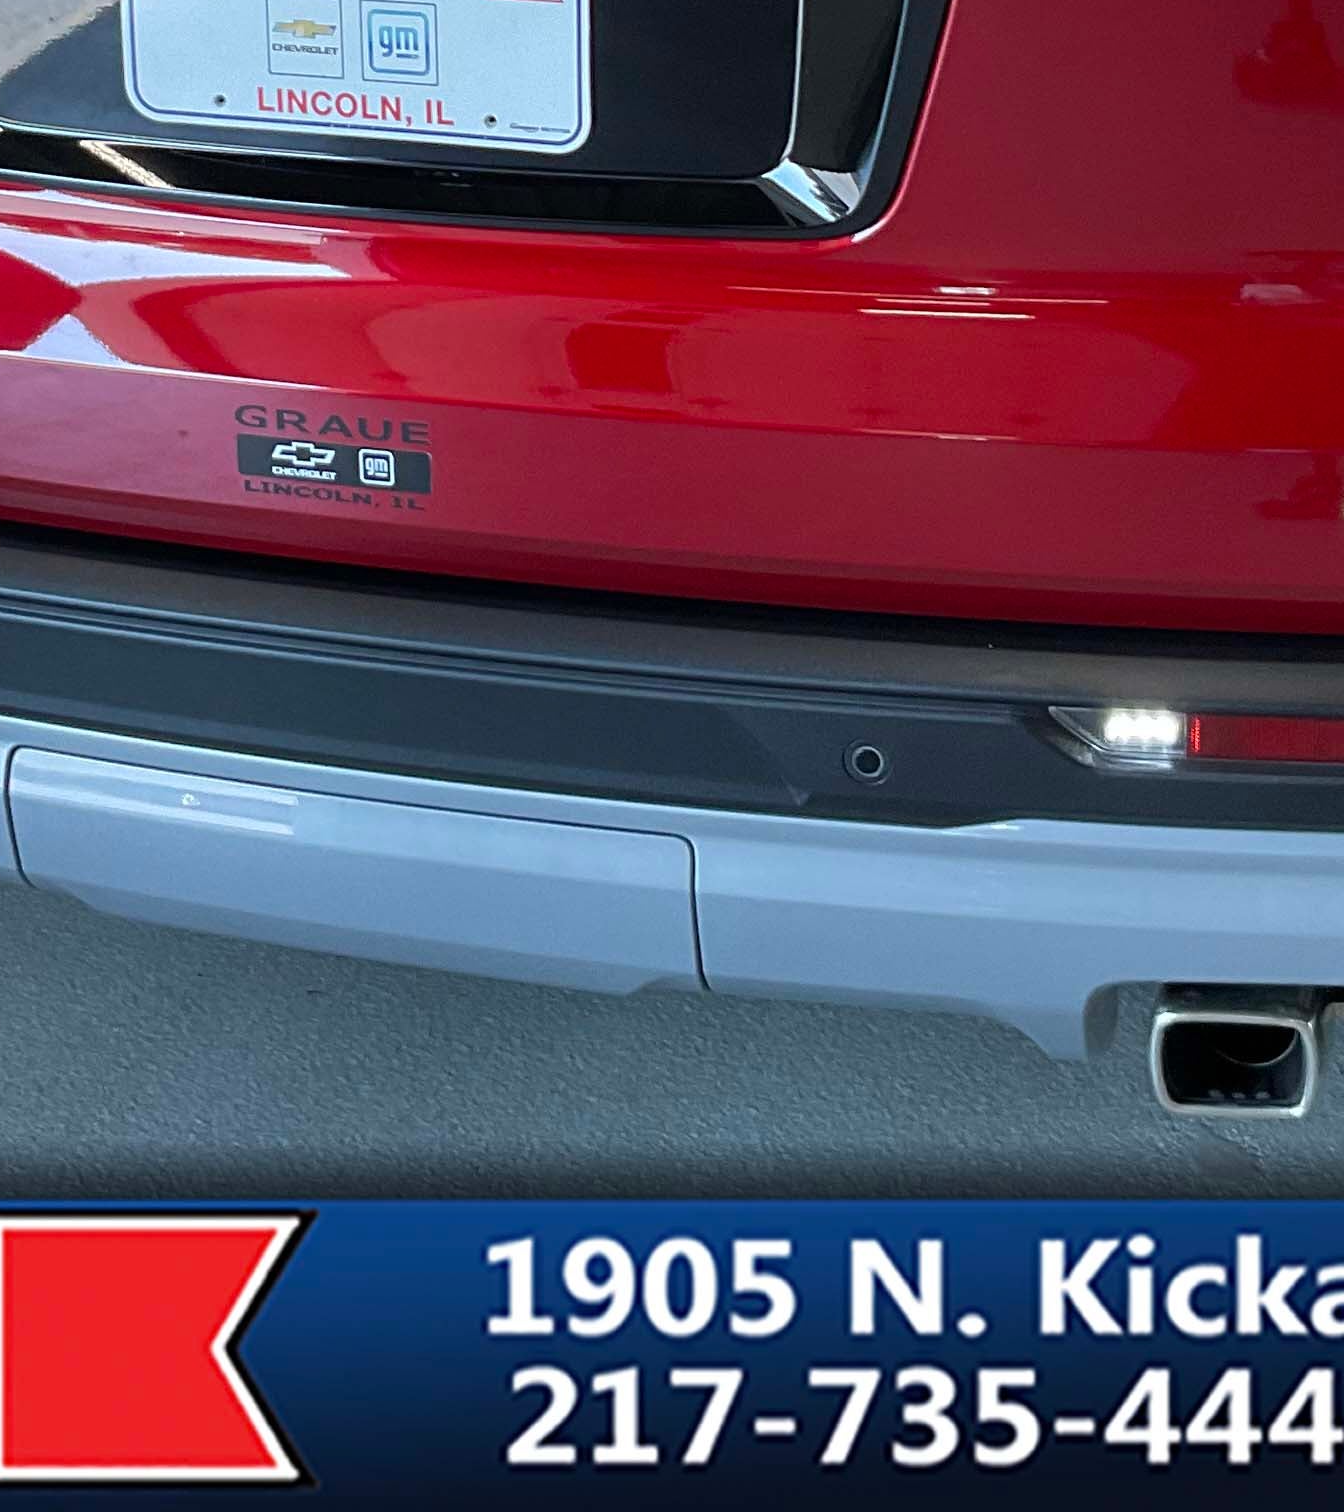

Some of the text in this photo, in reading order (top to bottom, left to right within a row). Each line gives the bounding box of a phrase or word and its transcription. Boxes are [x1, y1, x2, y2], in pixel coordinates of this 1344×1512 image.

[271, 42, 339, 56] CHEVROLET
[378, 25, 420, 59] gm
[256, 86, 455, 128] LINCOLN, IL
[234, 404, 431, 445] GRAUE
[271, 465, 337, 481] CHEVROLET
[364, 456, 389, 478] gm
[243, 479, 426, 511] LINCOLN, IL
